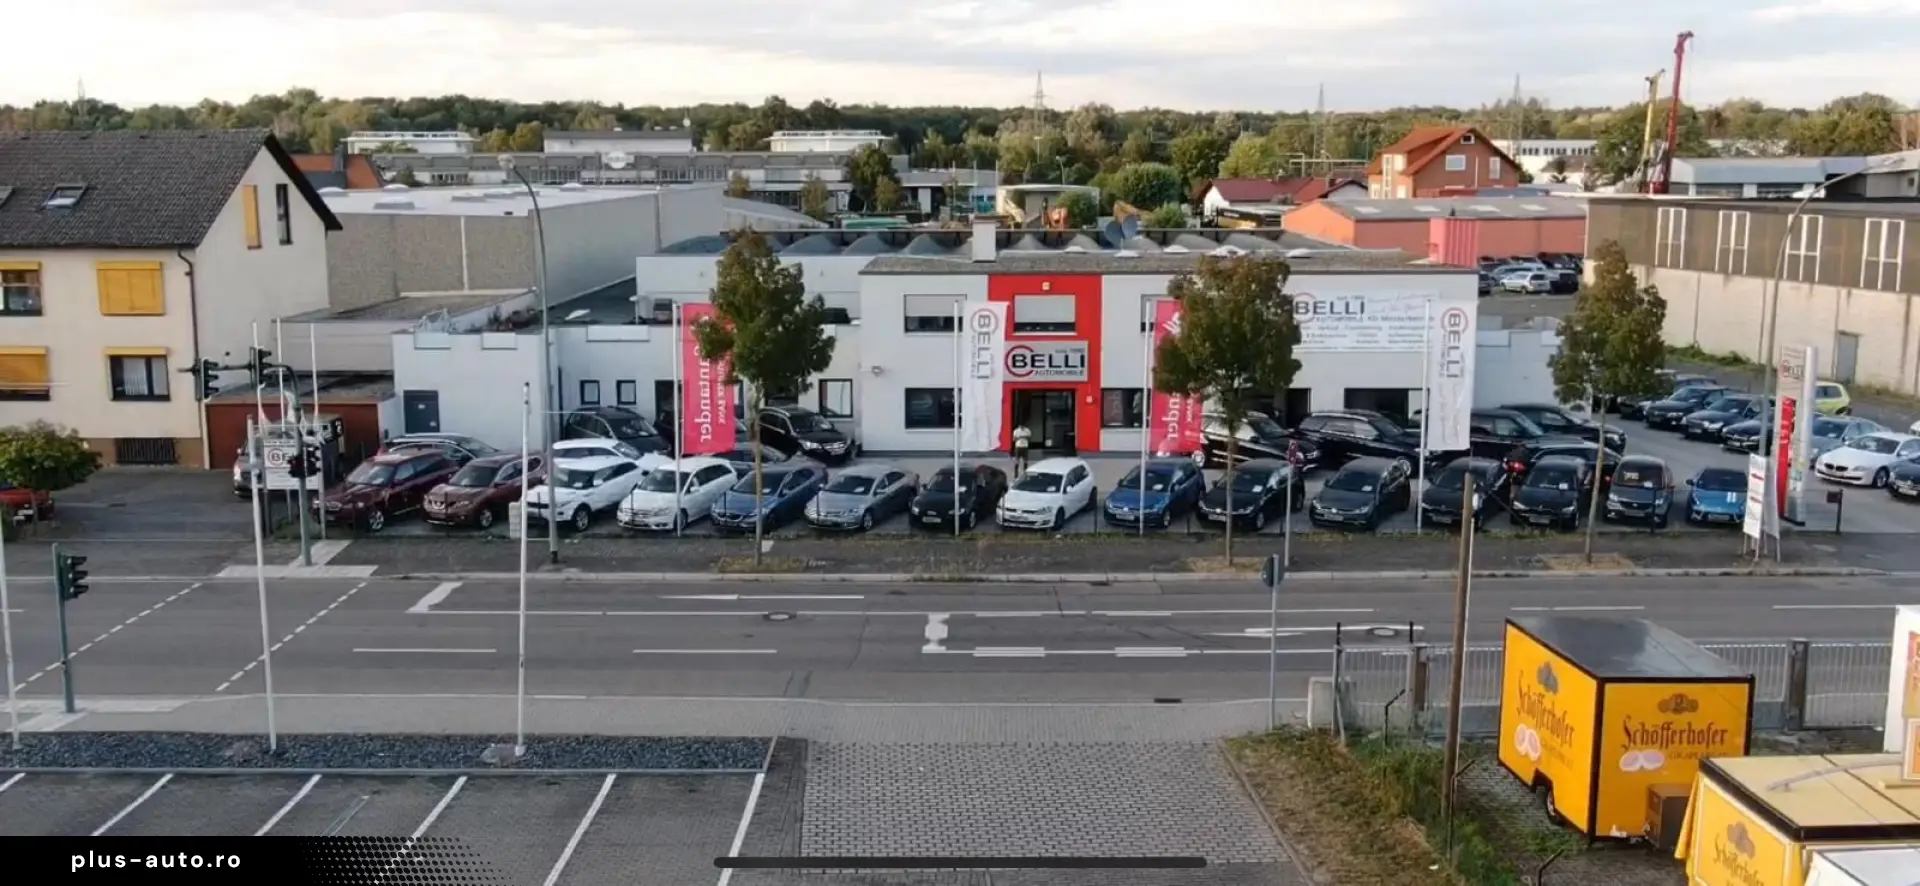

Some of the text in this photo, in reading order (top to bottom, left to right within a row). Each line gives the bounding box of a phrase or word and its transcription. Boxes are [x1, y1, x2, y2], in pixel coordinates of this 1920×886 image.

[1295, 300, 1365, 315] BELLI
[976, 314, 991, 379] BELLI
[1012, 353, 1085, 368] BELLI
[1446, 313, 1461, 378] BELLI
[1516, 669, 1576, 749] Schöfferhofer
[1621, 714, 1729, 751] Schöfferhofer
